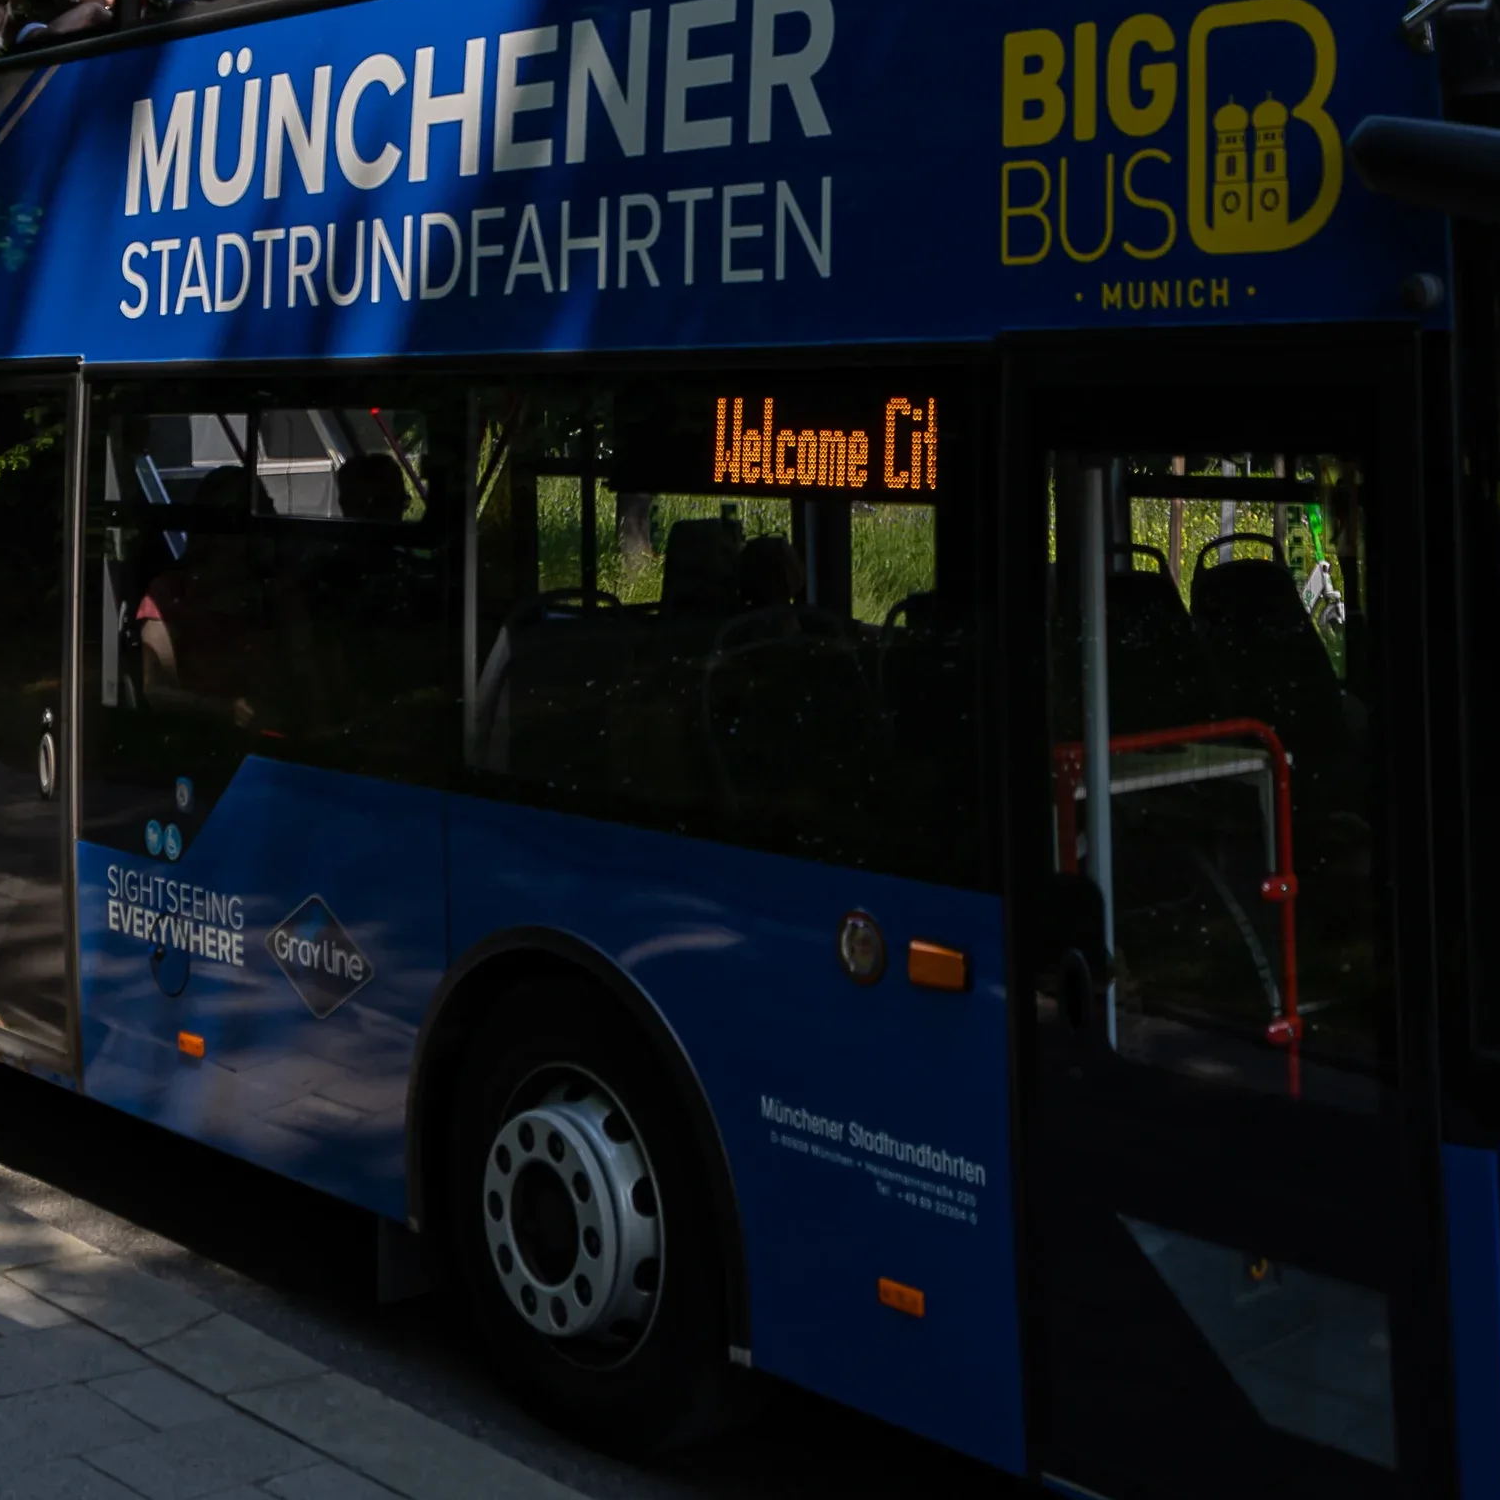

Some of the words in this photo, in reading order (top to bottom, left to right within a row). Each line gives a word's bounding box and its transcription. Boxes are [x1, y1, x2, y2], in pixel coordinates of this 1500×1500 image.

[1003, 14, 1178, 147] BIG
[120, 176, 833, 319] STADTRUNDFAHRTEN
[1002, 149, 1177, 265] BUS
[1102, 278, 1230, 310] MUNICH
[713, 397, 868, 487] Welcome
[108, 864, 245, 930] SIGHTSEEING
[108, 899, 245, 966] EVERYWHERE
[761, 1095, 844, 1142] Münchener
[849, 1121, 986, 1187] Stadtrundfahrten
